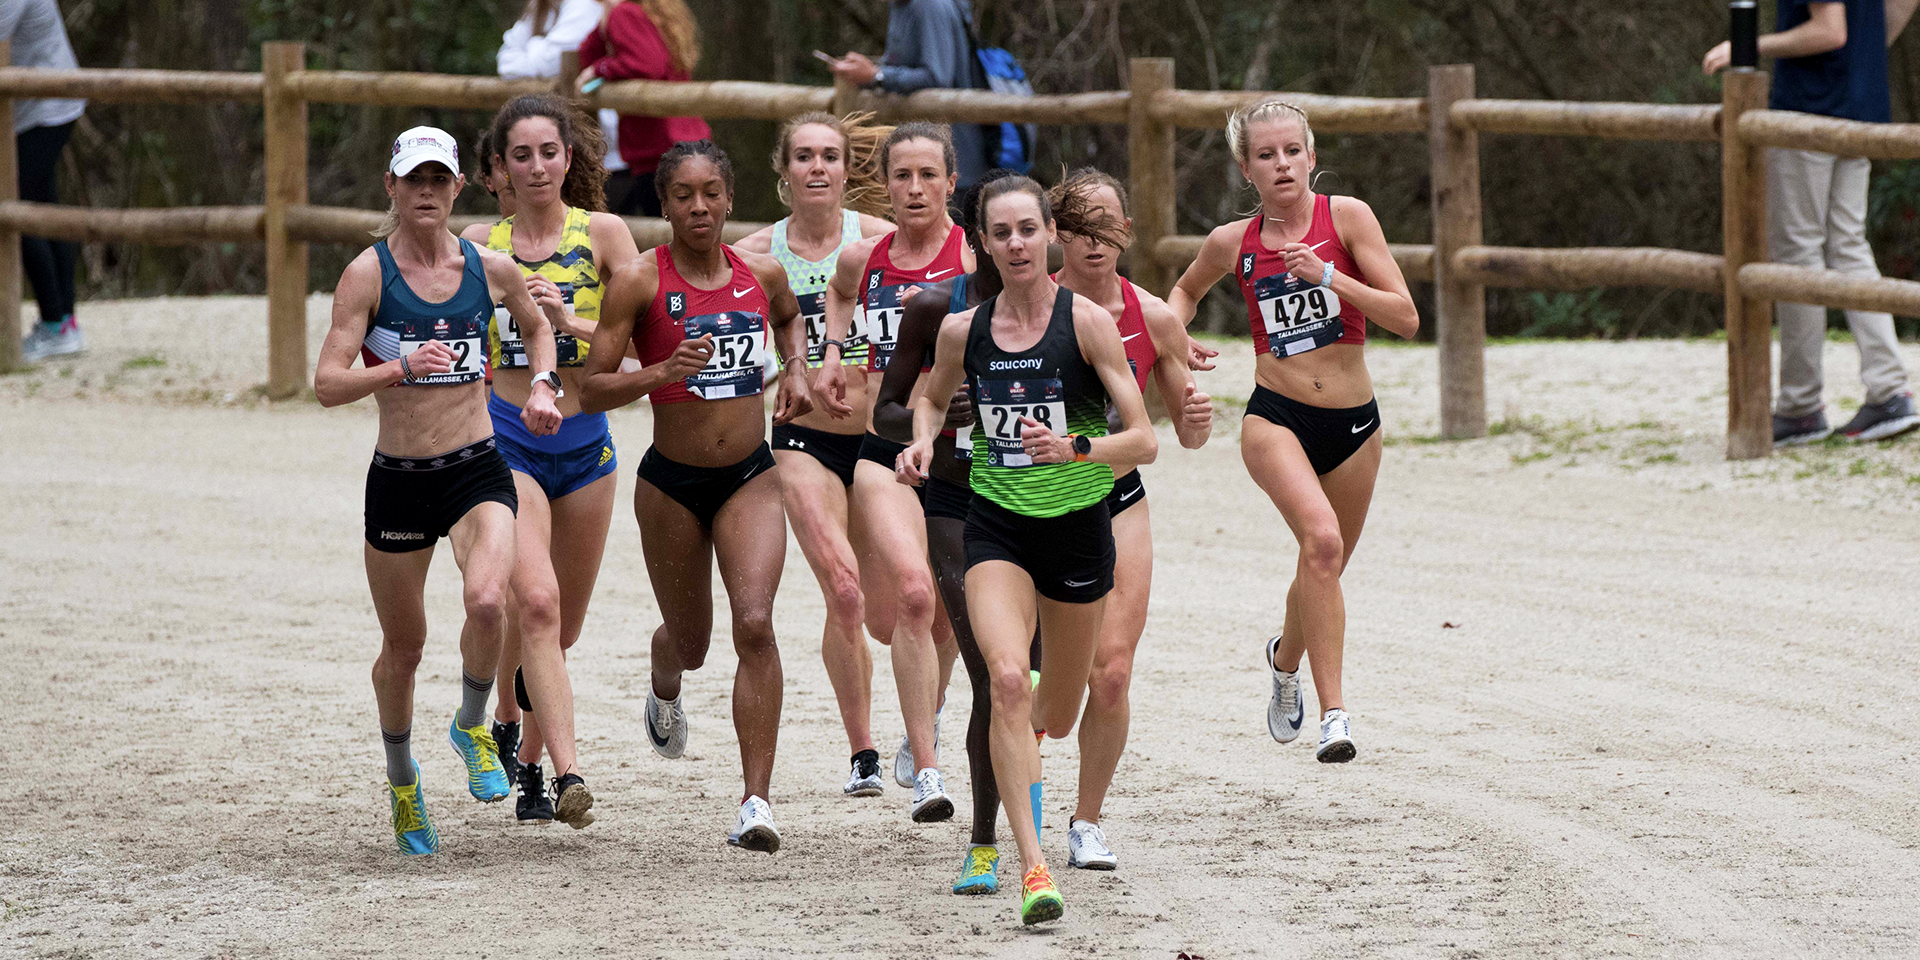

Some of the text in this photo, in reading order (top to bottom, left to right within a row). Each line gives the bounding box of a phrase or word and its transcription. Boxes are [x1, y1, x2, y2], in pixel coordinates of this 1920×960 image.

[1274, 288, 1328, 328] 429
[1277, 322, 1325, 339] TALLAHASSEE,
[989, 358, 1043, 371] saucony
[415, 375, 462, 383] ALLAHASSEE,
[697, 371, 746, 380] TALLAHASSEE,
[991, 405, 1052, 439] 278
[381, 530, 412, 540] HOKA
